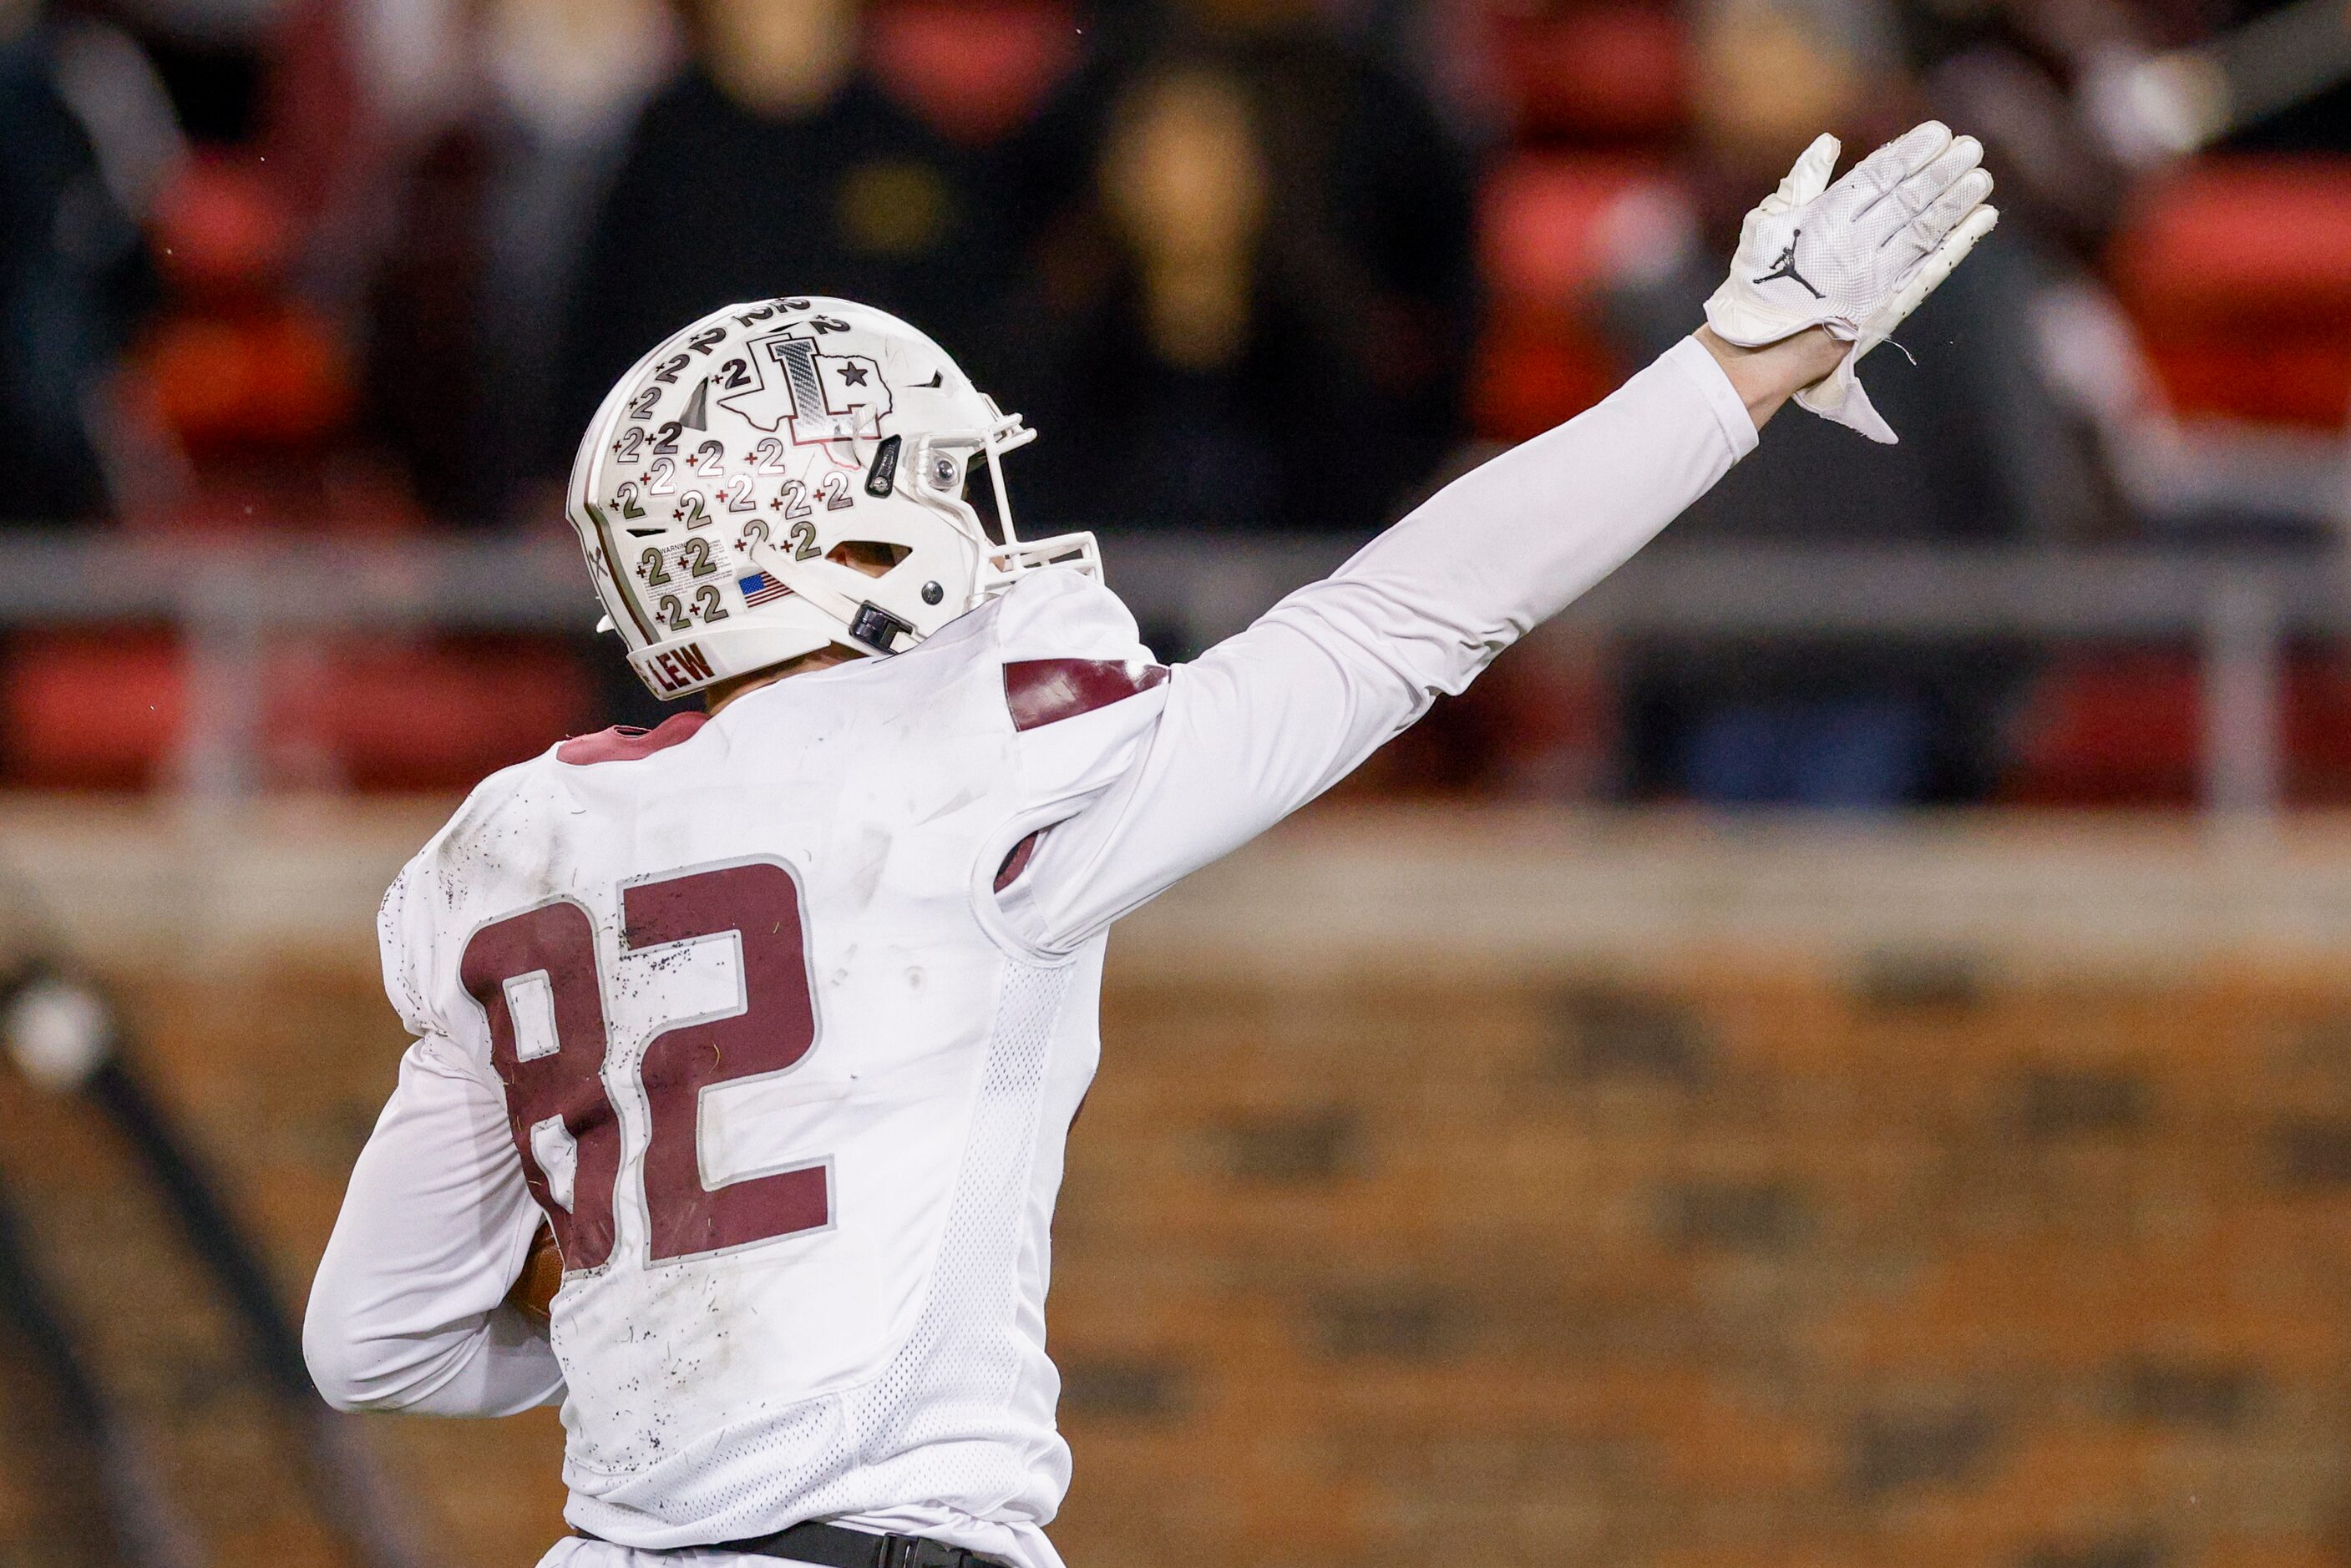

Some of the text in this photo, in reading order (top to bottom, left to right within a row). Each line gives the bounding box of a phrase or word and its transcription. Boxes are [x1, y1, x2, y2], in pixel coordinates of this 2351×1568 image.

[712, 358, 751, 390] +2
[629, 387, 661, 419] +2
[612, 427, 644, 463] +2
[645, 422, 682, 455] +2
[744, 438, 785, 475] +2
[640, 458, 676, 495] +2
[686, 440, 725, 477] +2
[610, 482, 646, 519] +2
[673, 490, 712, 530] +2
[717, 473, 757, 513] +2
[771, 479, 813, 519] +2
[813, 472, 854, 511] +2
[677, 537, 717, 578] +2
[780, 521, 822, 562] +2
[636, 547, 671, 587] +2
[656, 594, 692, 631] +2
[689, 584, 730, 624] +2
[456, 852, 838, 1282] 82
